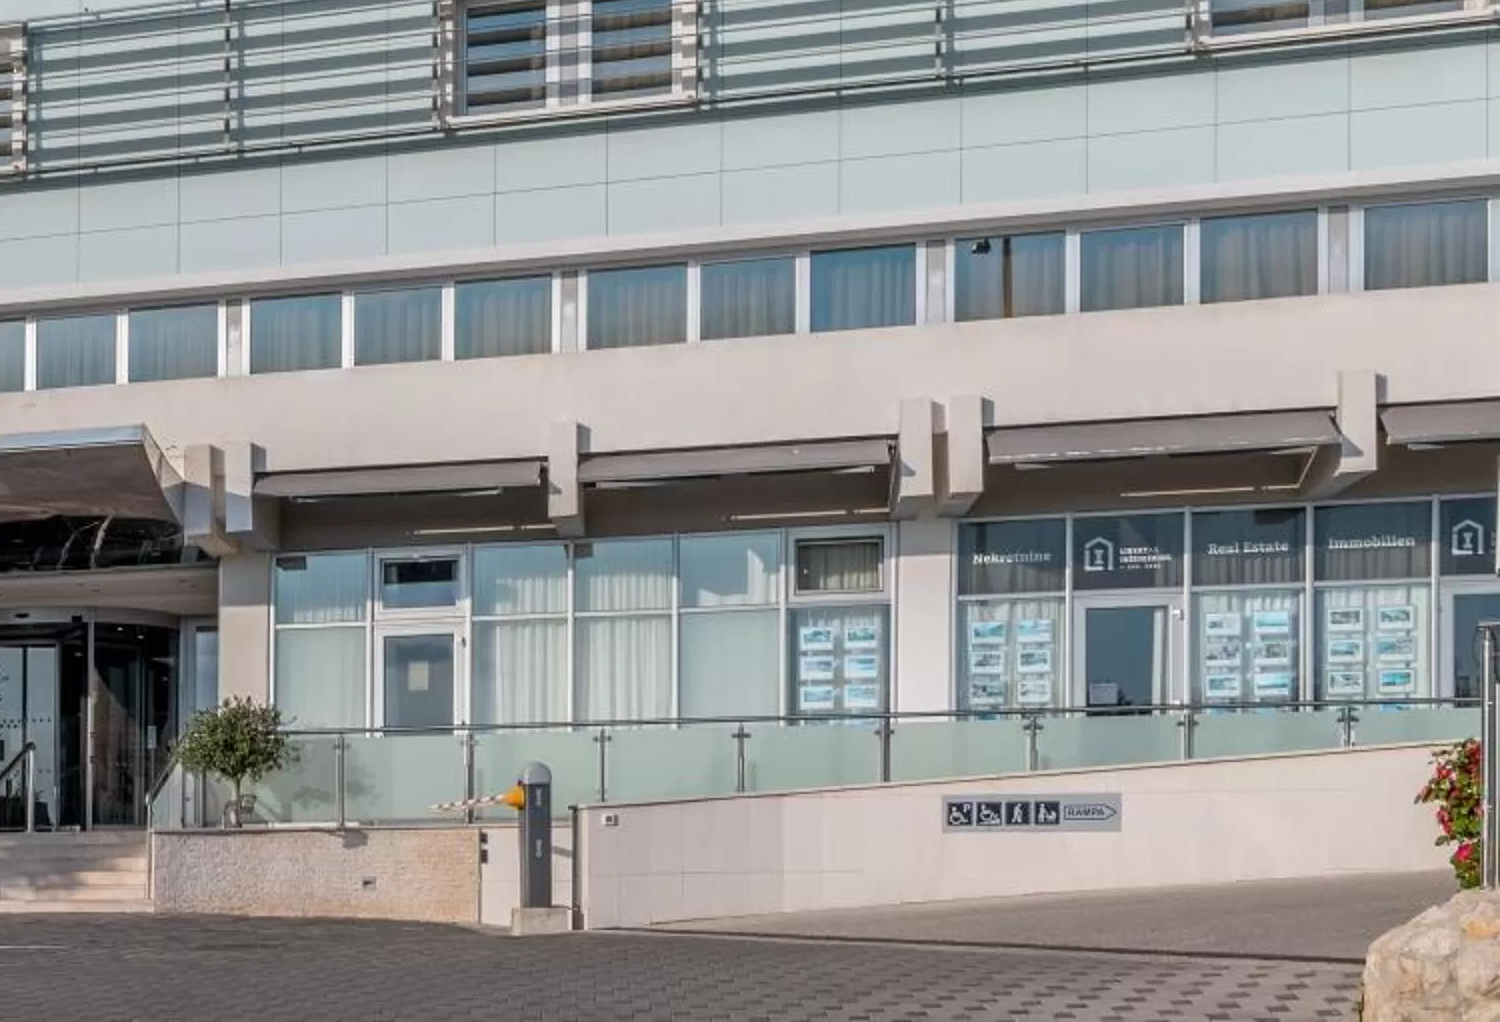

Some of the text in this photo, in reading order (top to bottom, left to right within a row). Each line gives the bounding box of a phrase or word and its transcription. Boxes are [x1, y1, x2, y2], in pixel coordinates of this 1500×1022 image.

[1207, 540, 1289, 555] Real Estate
[1328, 534, 1415, 550] Immobilien
